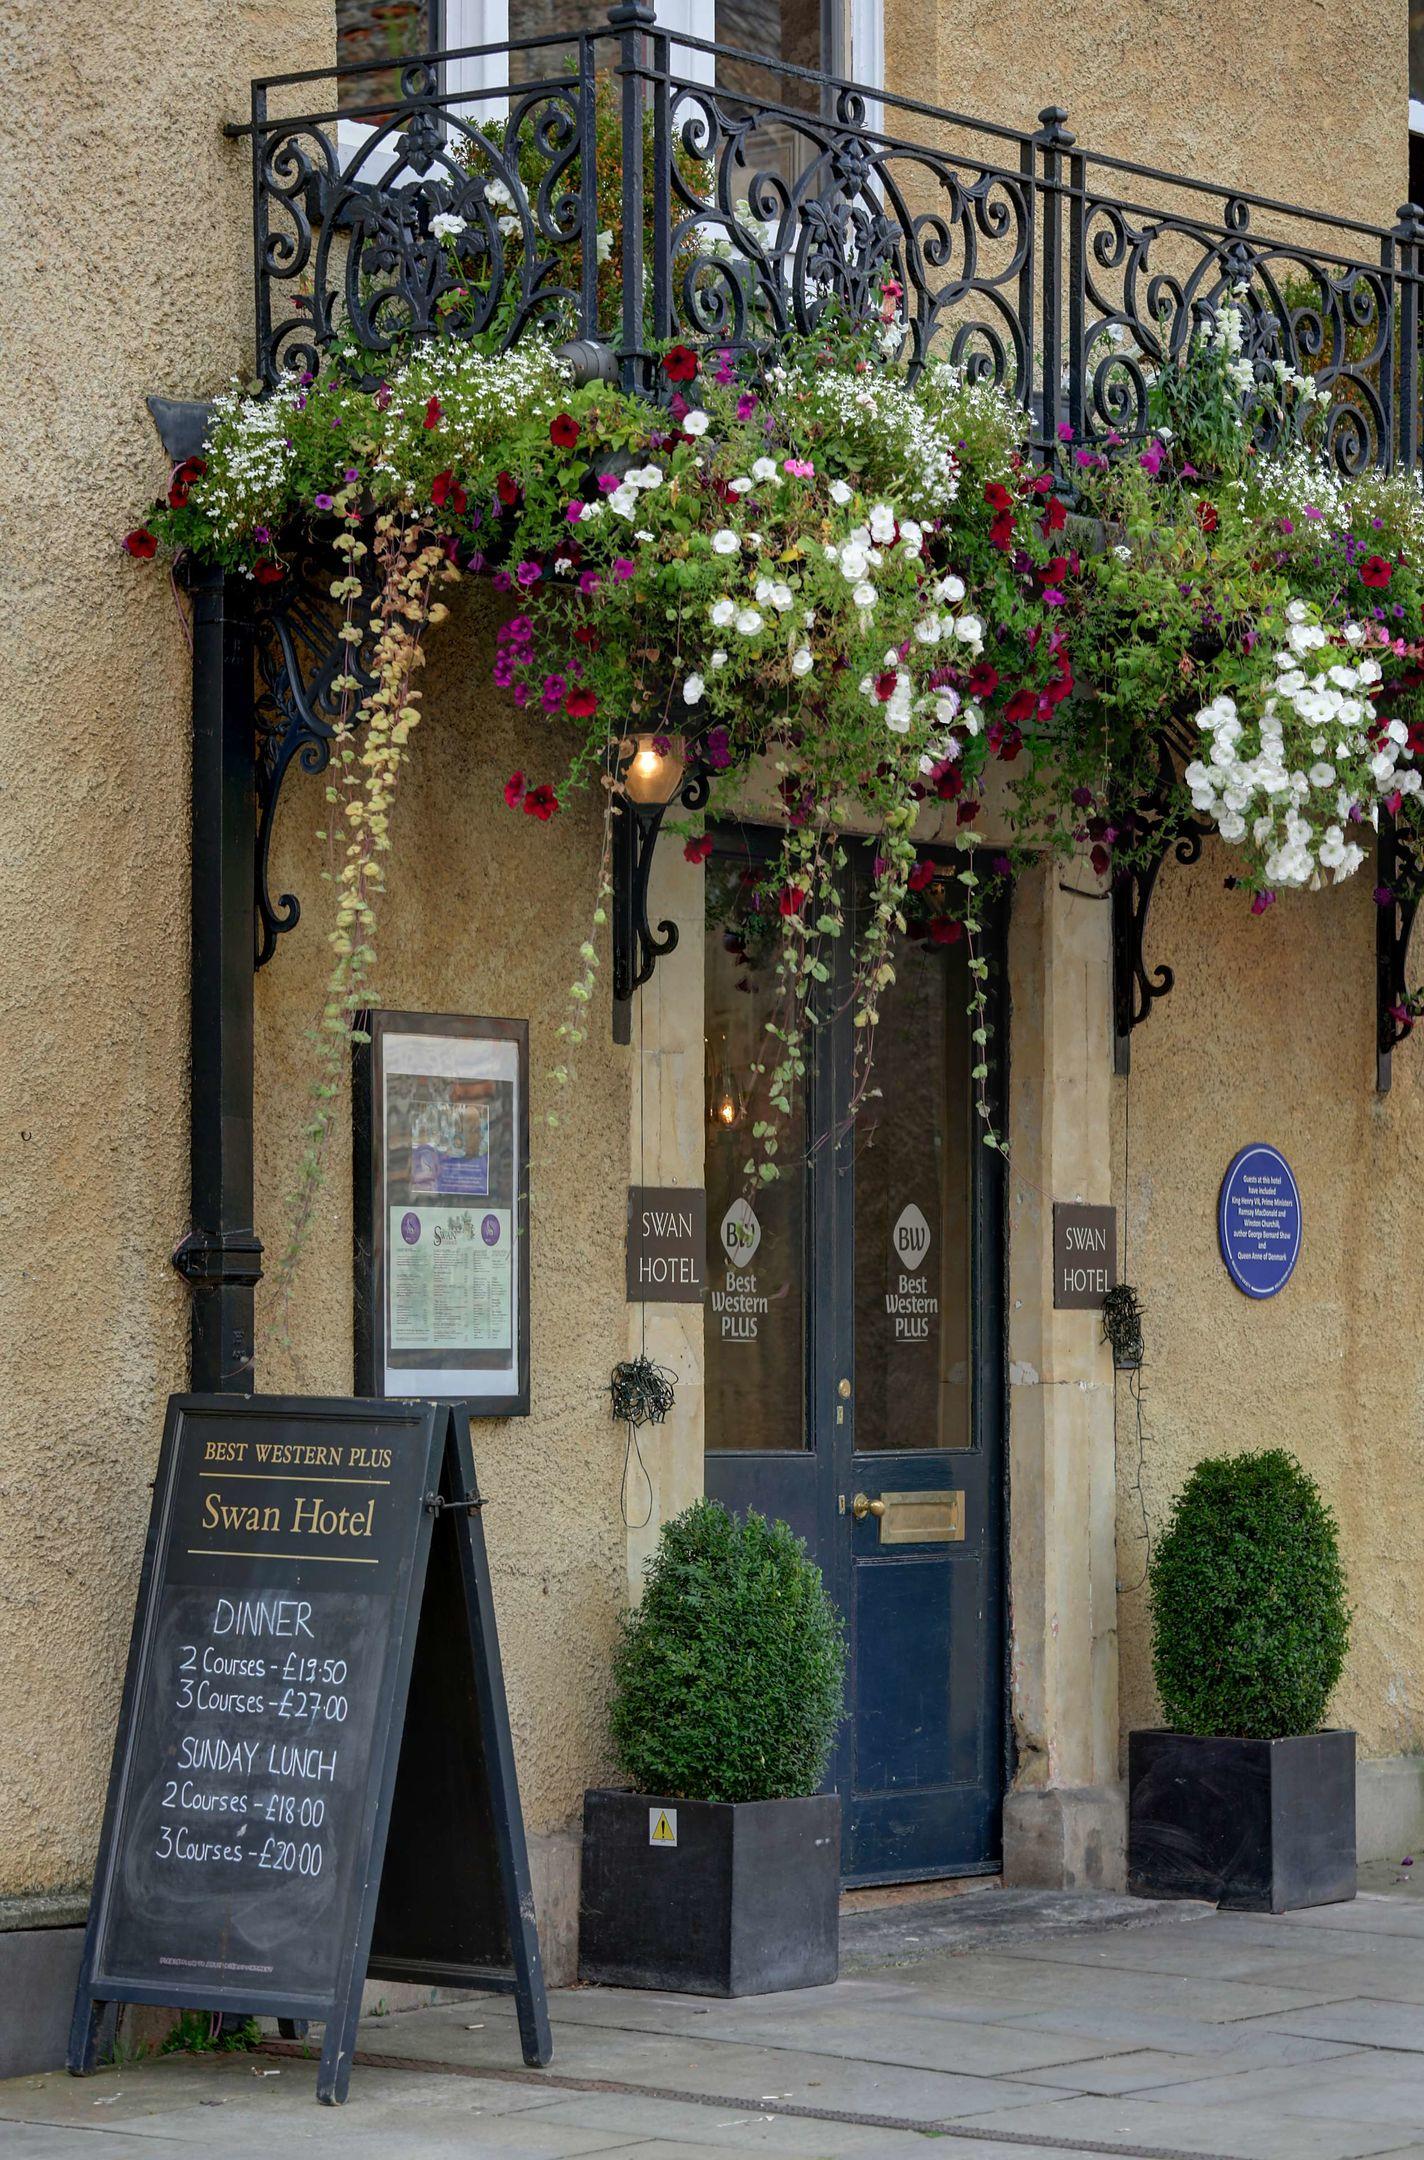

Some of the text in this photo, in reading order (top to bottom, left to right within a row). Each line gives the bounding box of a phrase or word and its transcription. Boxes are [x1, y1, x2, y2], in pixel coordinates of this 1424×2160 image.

[1243, 1175, 1257, 1183] Guests
[1262, 1176, 1270, 1184] this
[1271, 1176, 1281, 1185] hotel
[1248, 1186, 1276, 1195] have included
[1232, 1196, 1240, 1206] King
[1241, 1197, 1253, 1206] Henry
[1262, 1198, 1273, 1206] Prime
[1274, 1198, 1292, 1207] Ministers
[1238, 1207, 1254, 1217] Ramsay
[1278, 1209, 1286, 1217] and
[642, 1212, 692, 1238] SWAN
[1243, 1219, 1261, 1227] Winston
[1247, 1230, 1262, 1239] George
[1280, 1231, 1291, 1239] Shaw
[899, 1227, 925, 1251] BW
[1065, 1227, 1106, 1251] SWAN
[1258, 1241, 1266, 1249] and
[1238, 1251, 1251, 1260] Queen
[1252, 1252, 1262, 1260] Anne
[639, 1257, 700, 1283] HOTEL
[1064, 1268, 1112, 1292] HOTEL
[726, 1272, 757, 1293] Best
[899, 1274, 927, 1294] Best
[711, 1291, 768, 1314] Western
[885, 1295, 938, 1314] Western
[721, 1316, 758, 1337] PLUS
[895, 1317, 929, 1337] PLUS
[204, 1441, 392, 1468] BEST WESTERN PLUS
[202, 1493, 375, 1536] Swan Hotel
[213, 1599, 315, 1638] DINNER
[179, 1646, 198, 1670] 2
[203, 1647, 266, 1677] Courses
[176, 1679, 194, 1709] 3
[197, 1680, 264, 1714] Courses
[177, 1737, 337, 1782] SUNDAY LUNCH
[161, 1781, 177, 1808] 2
[181, 1780, 248, 1813] Courses
[156, 1826, 172, 1858] 3
[175, 1827, 242, 1862] Courses
